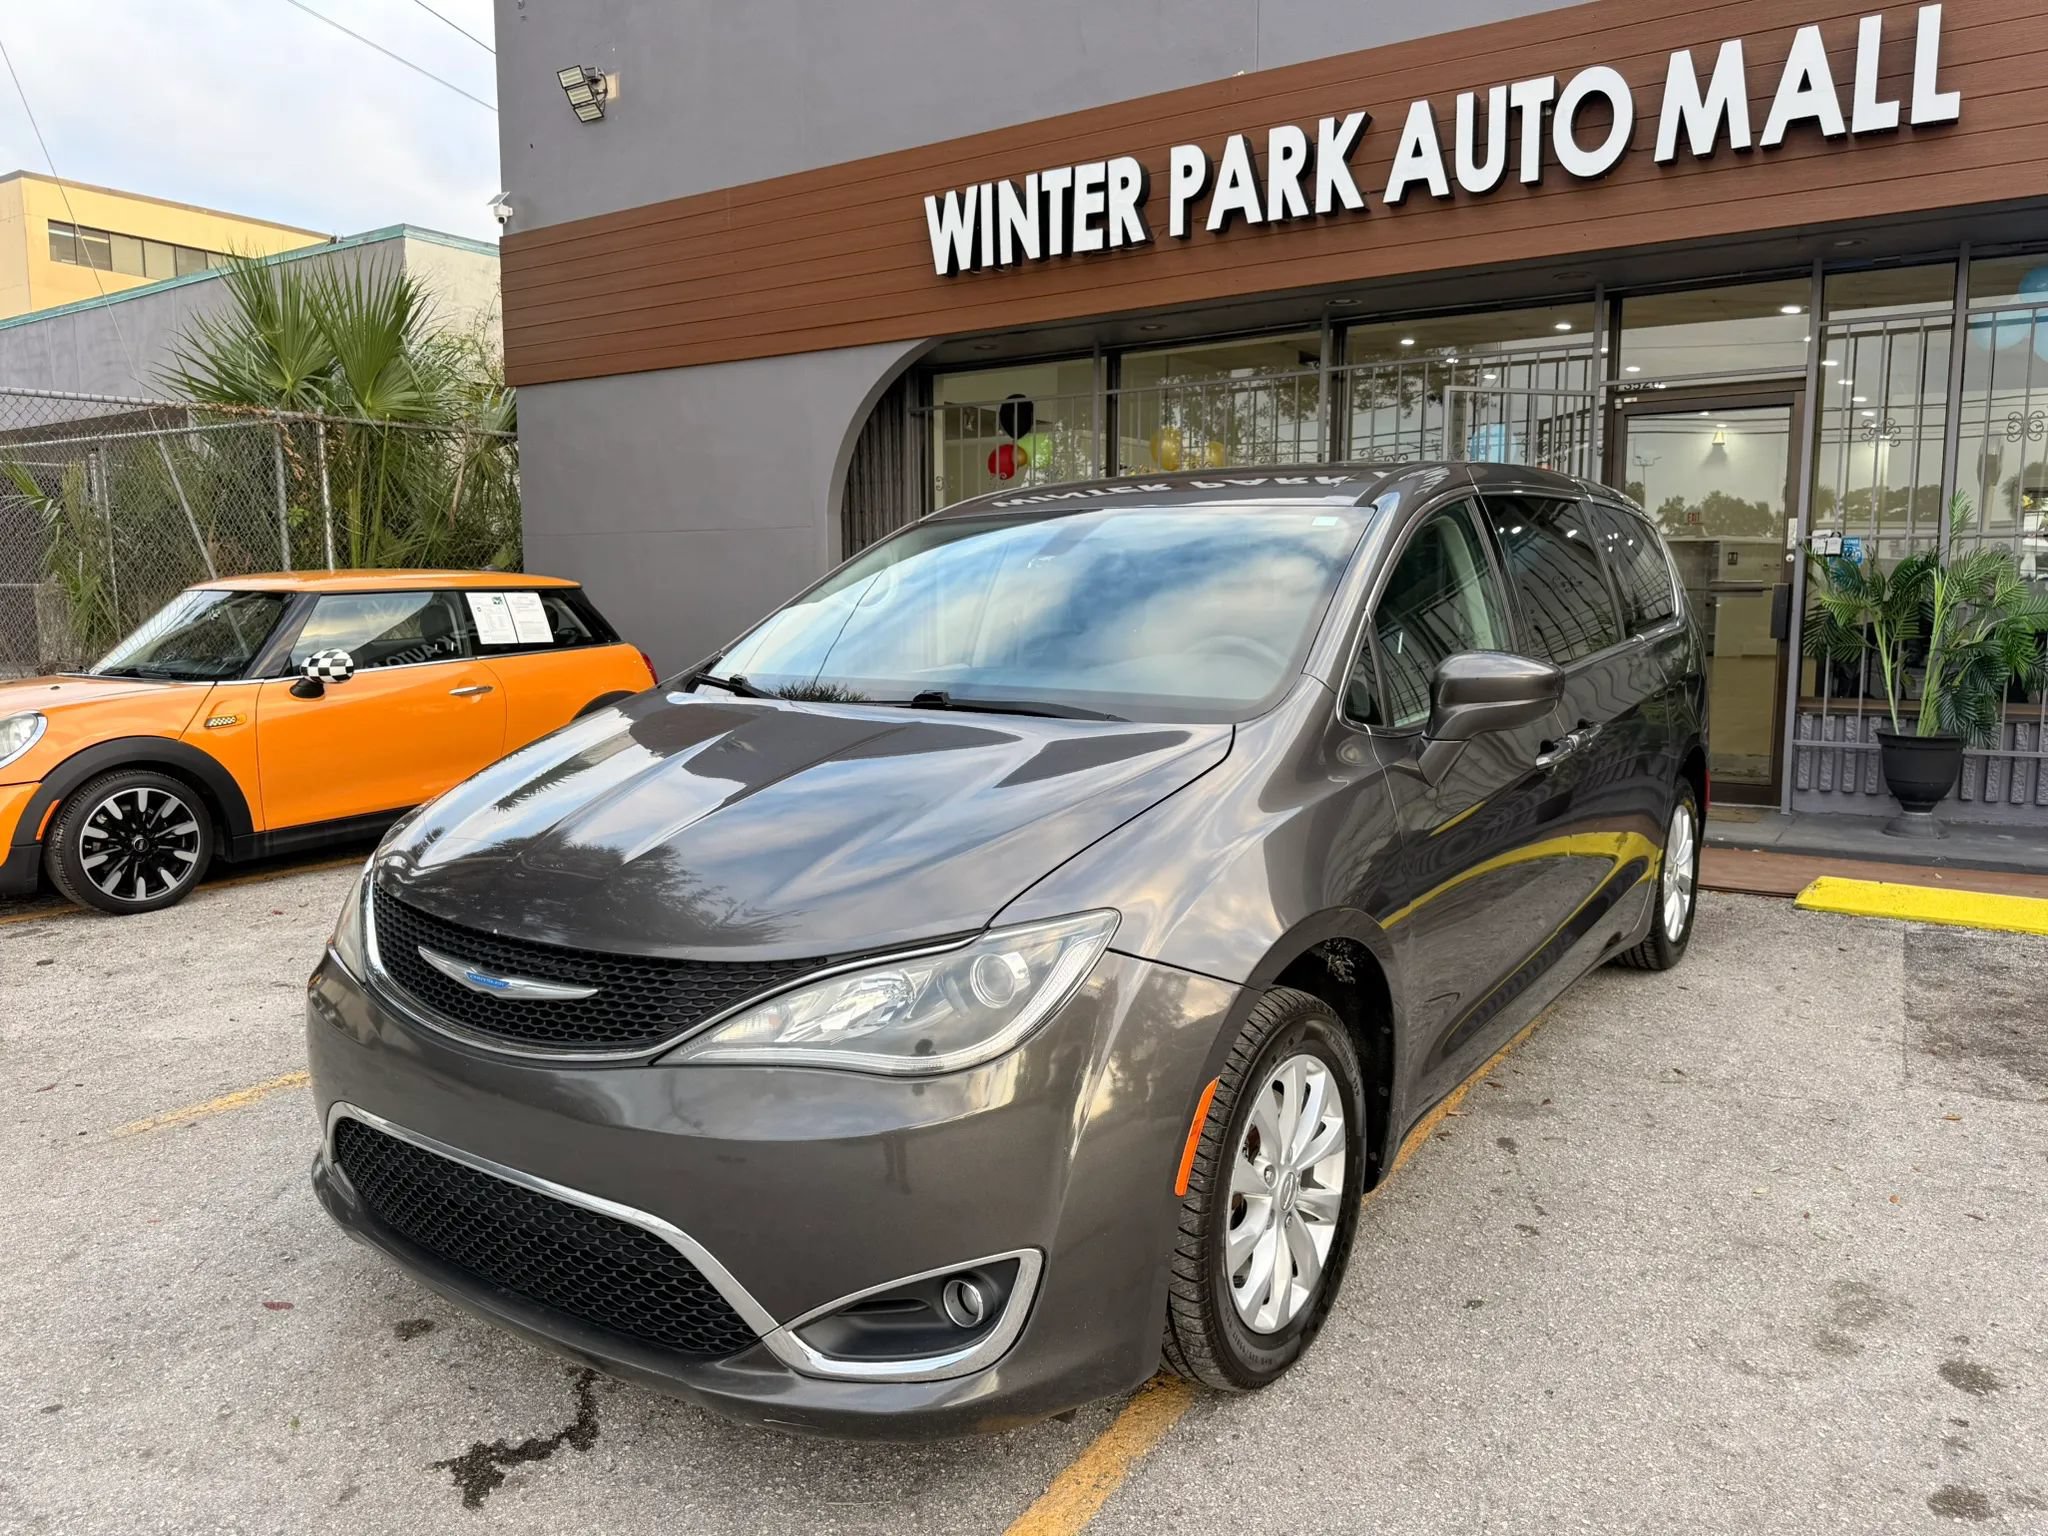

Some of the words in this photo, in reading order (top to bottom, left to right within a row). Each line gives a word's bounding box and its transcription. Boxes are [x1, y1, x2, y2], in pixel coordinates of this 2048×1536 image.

[924, 156, 1147, 275] WINTER
[1169, 112, 1365, 237] PARK
[1383, 66, 1634, 203] AUTO
[1654, 3, 1960, 162] MALL
